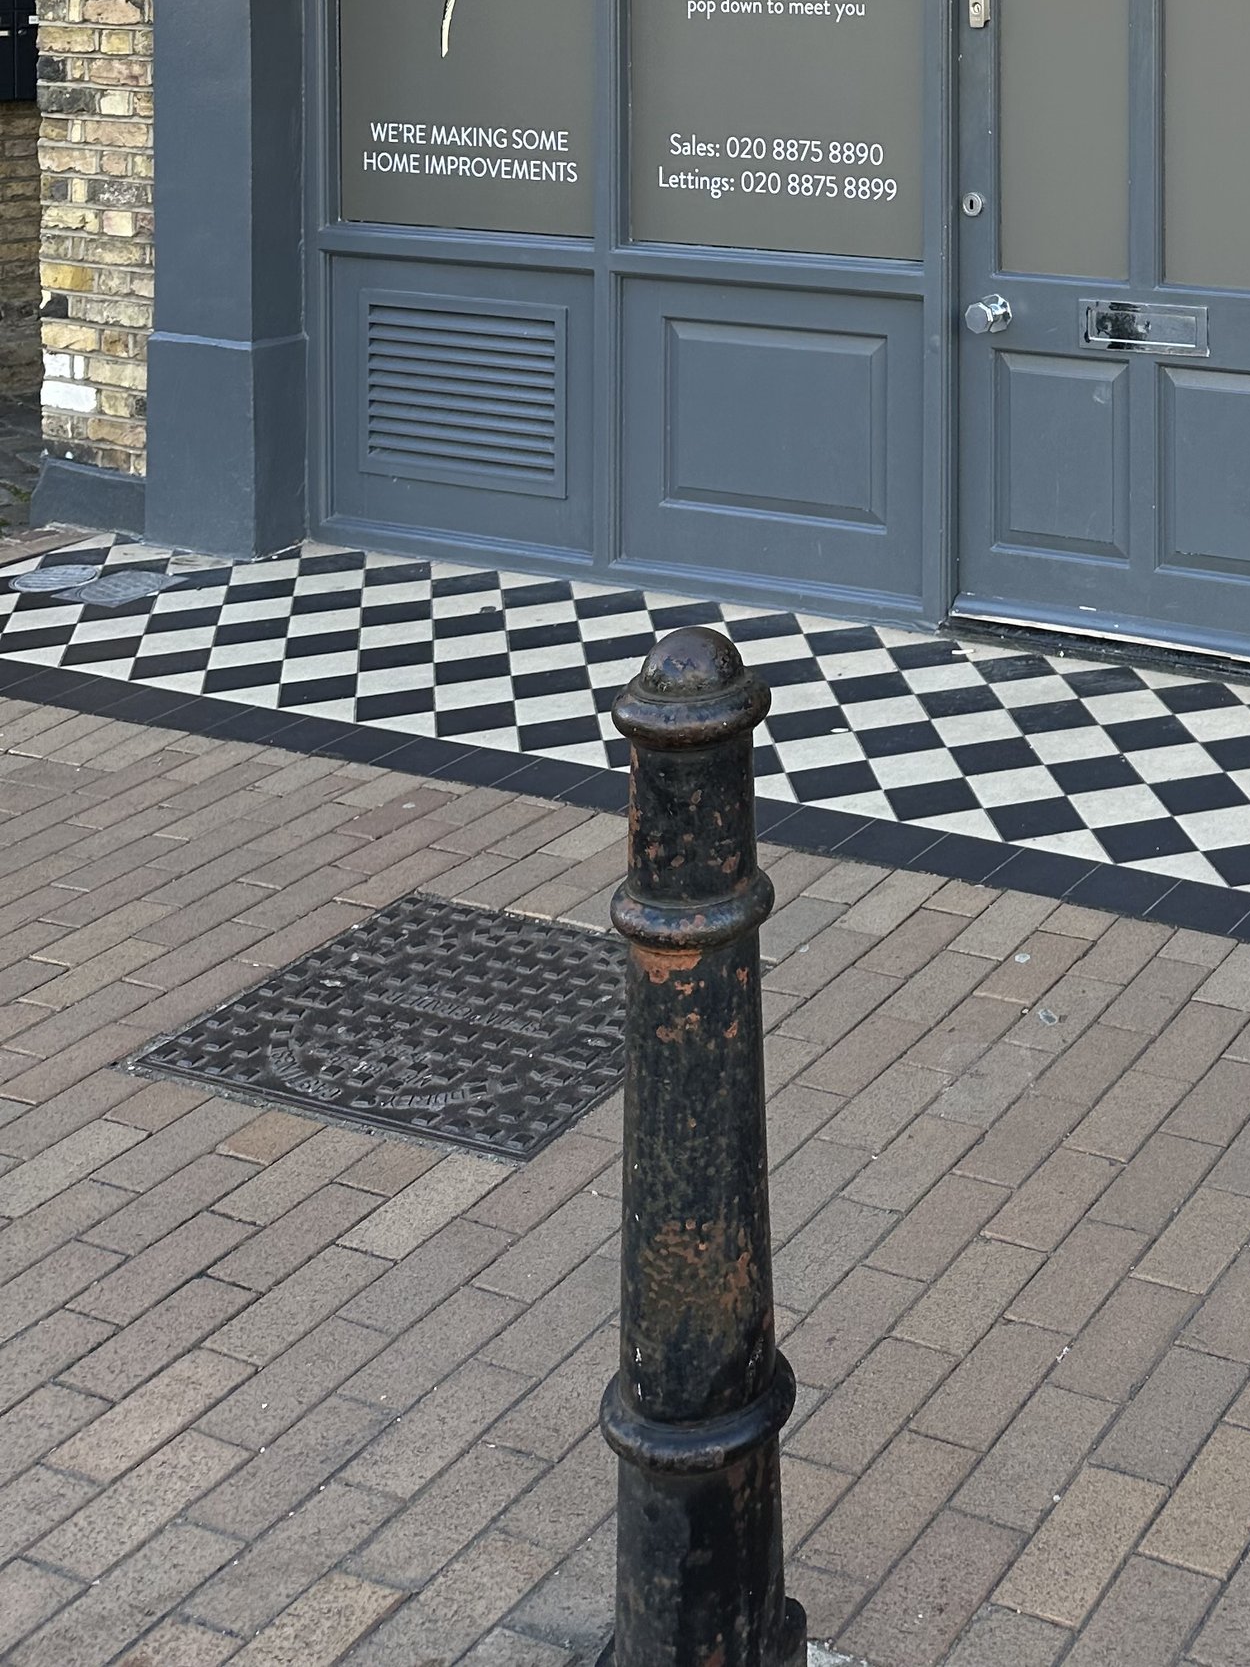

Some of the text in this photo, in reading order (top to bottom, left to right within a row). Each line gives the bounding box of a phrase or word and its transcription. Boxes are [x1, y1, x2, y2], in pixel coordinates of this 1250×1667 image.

[688, 0, 716, 19] pop
[767, 0, 784, 14] to
[789, 0, 830, 15] meet
[835, 4, 865, 22] you
[431, 125, 507, 148] MAKING
[512, 129, 568, 151] SOME
[670, 133, 883, 165] Sales: 020 8875 8890
[364, 151, 577, 182] HOME IMPROVEMENTS
[659, 166, 897, 201] Lettings: 020 8875 8899
